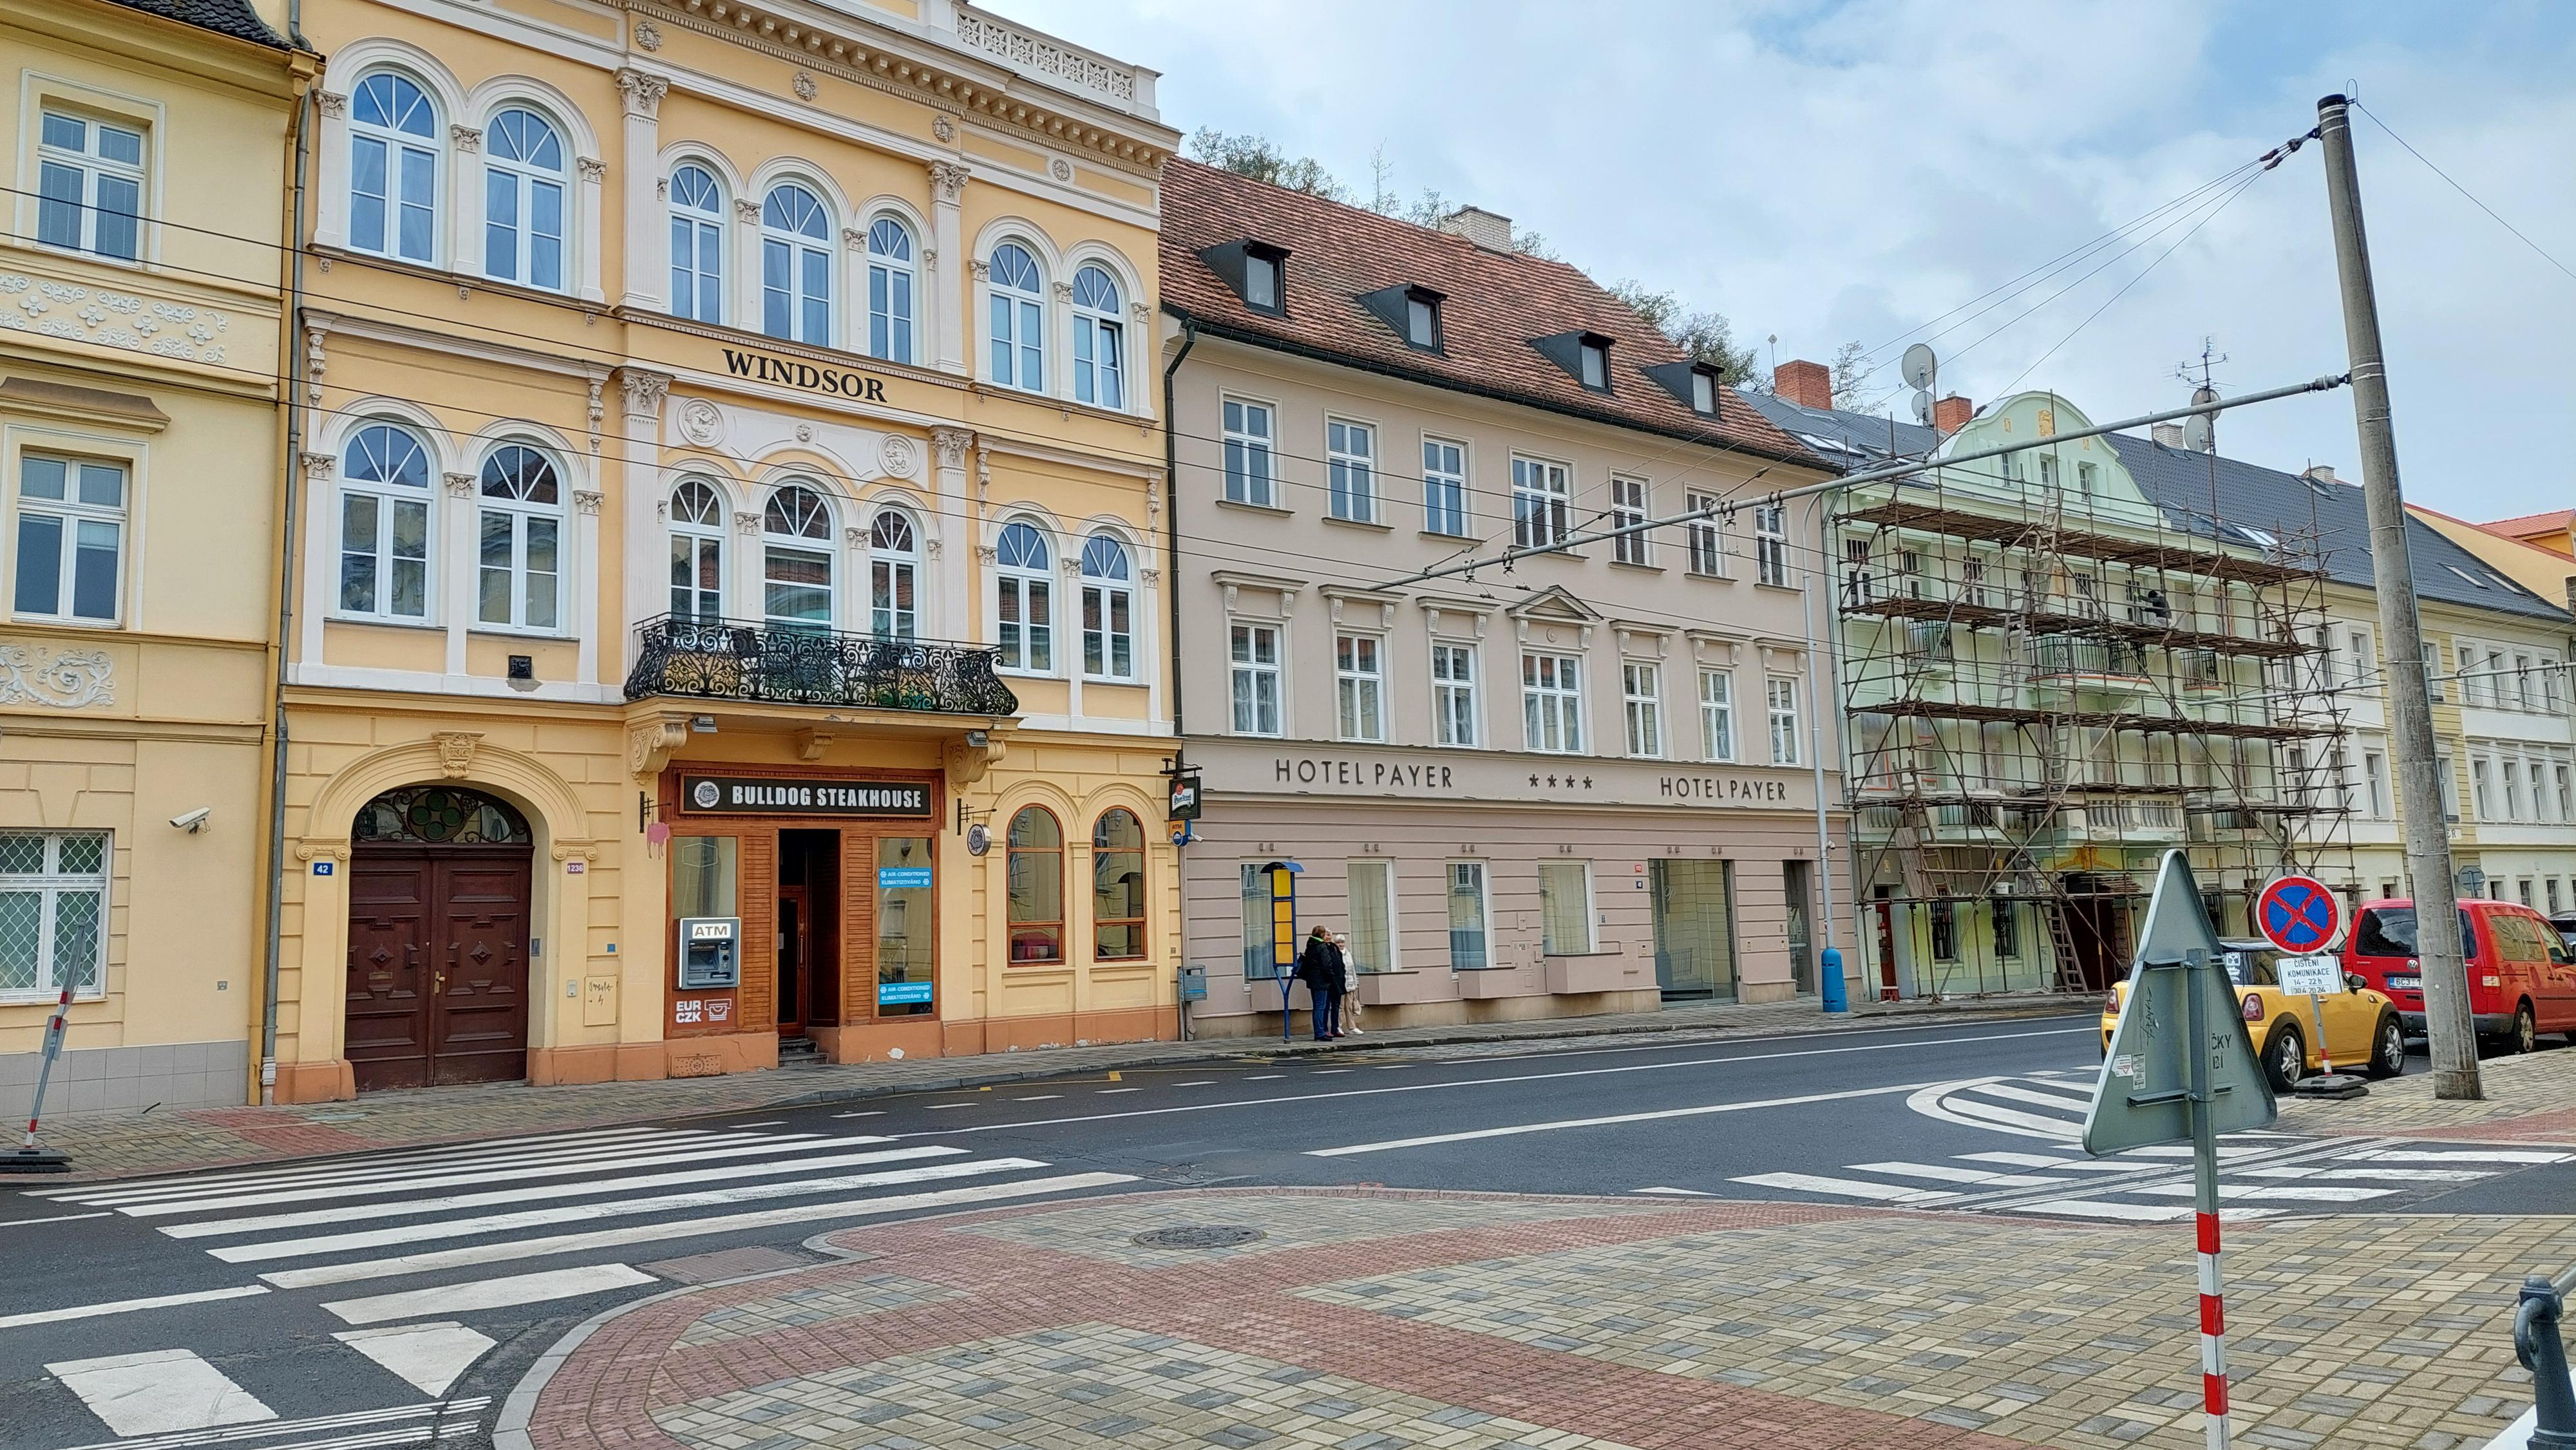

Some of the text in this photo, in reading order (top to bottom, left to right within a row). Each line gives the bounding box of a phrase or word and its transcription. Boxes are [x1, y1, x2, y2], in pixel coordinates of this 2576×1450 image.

[722, 348, 887, 403] WINDSOR
[1276, 758, 1453, 788] HOTEL PAYER
[1660, 777, 1786, 800] HOTEL PAYER
[732, 786, 922, 808] BULLDOG STEAKHOUSE
[317, 865, 328, 873] 42
[694, 926, 728, 936] ATM
[2287, 968, 2331, 977] KOMUNIKACE
[676, 1000, 701, 1012] EUR
[676, 1012, 702, 1023] CZK
